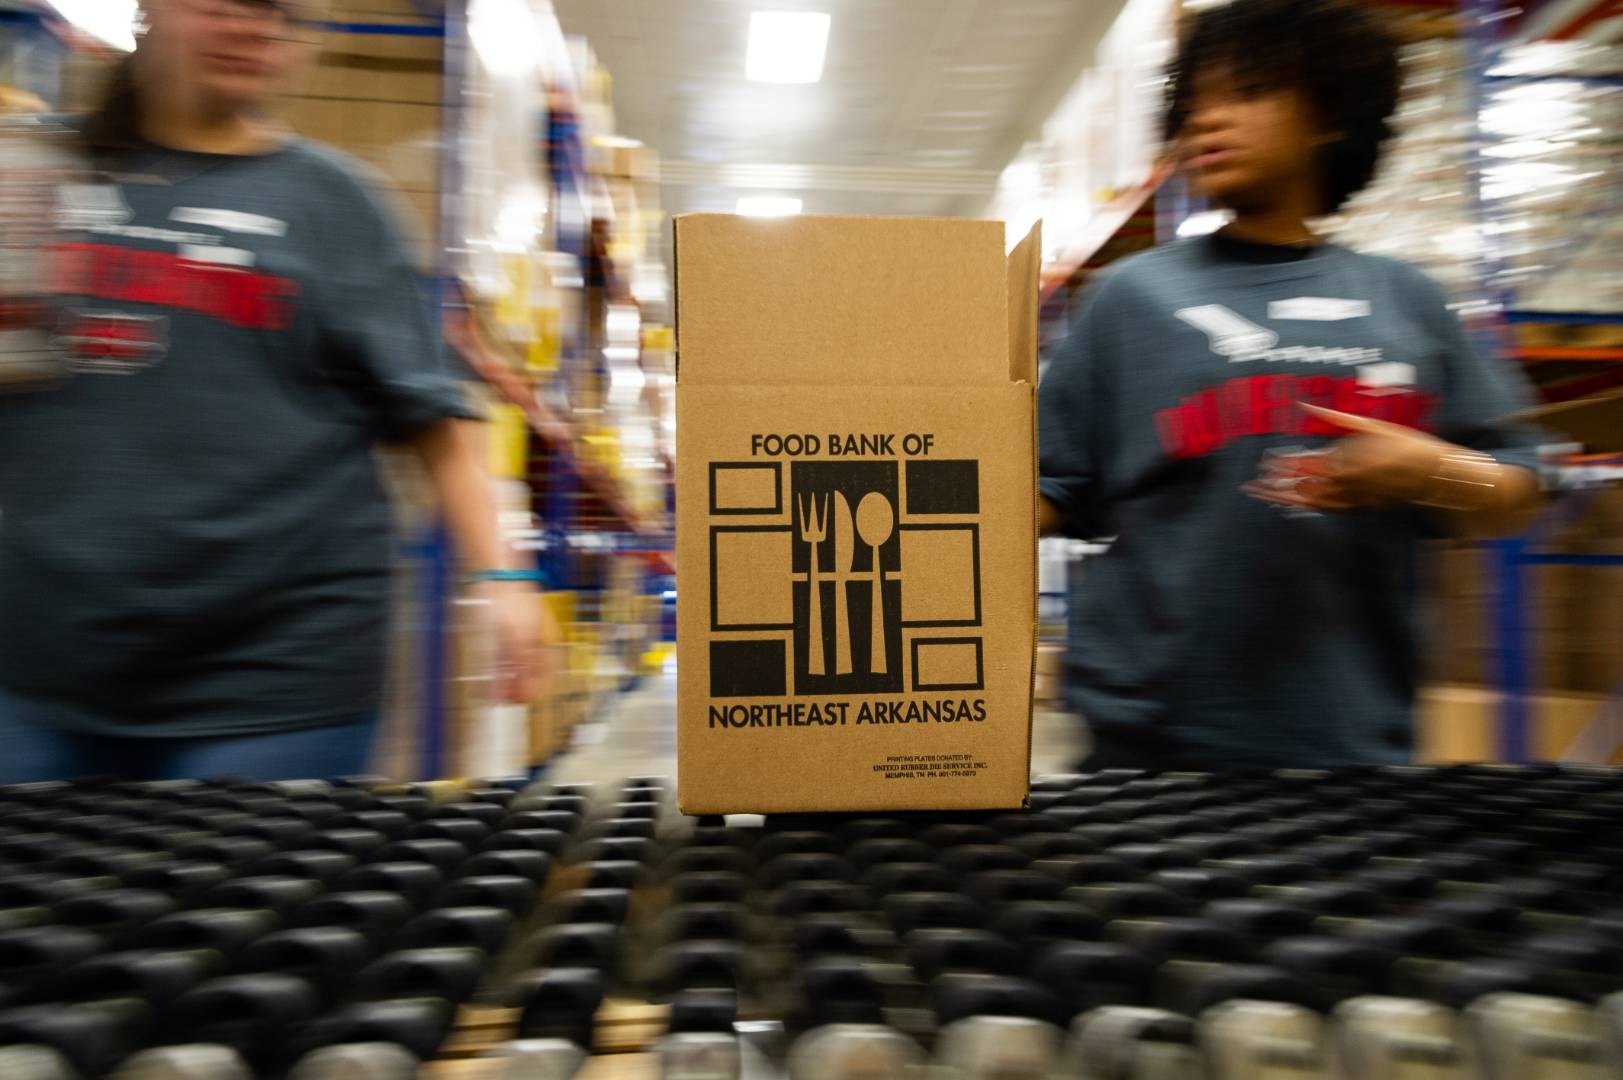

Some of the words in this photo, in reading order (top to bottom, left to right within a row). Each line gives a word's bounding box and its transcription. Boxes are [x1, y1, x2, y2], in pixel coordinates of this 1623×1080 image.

[751, 434, 821, 456] FOOD
[828, 434, 895, 456] BANK
[902, 434, 935, 456] OF
[708, 703, 849, 728] NORTHEAST
[856, 699, 987, 724] ARKANSAS
